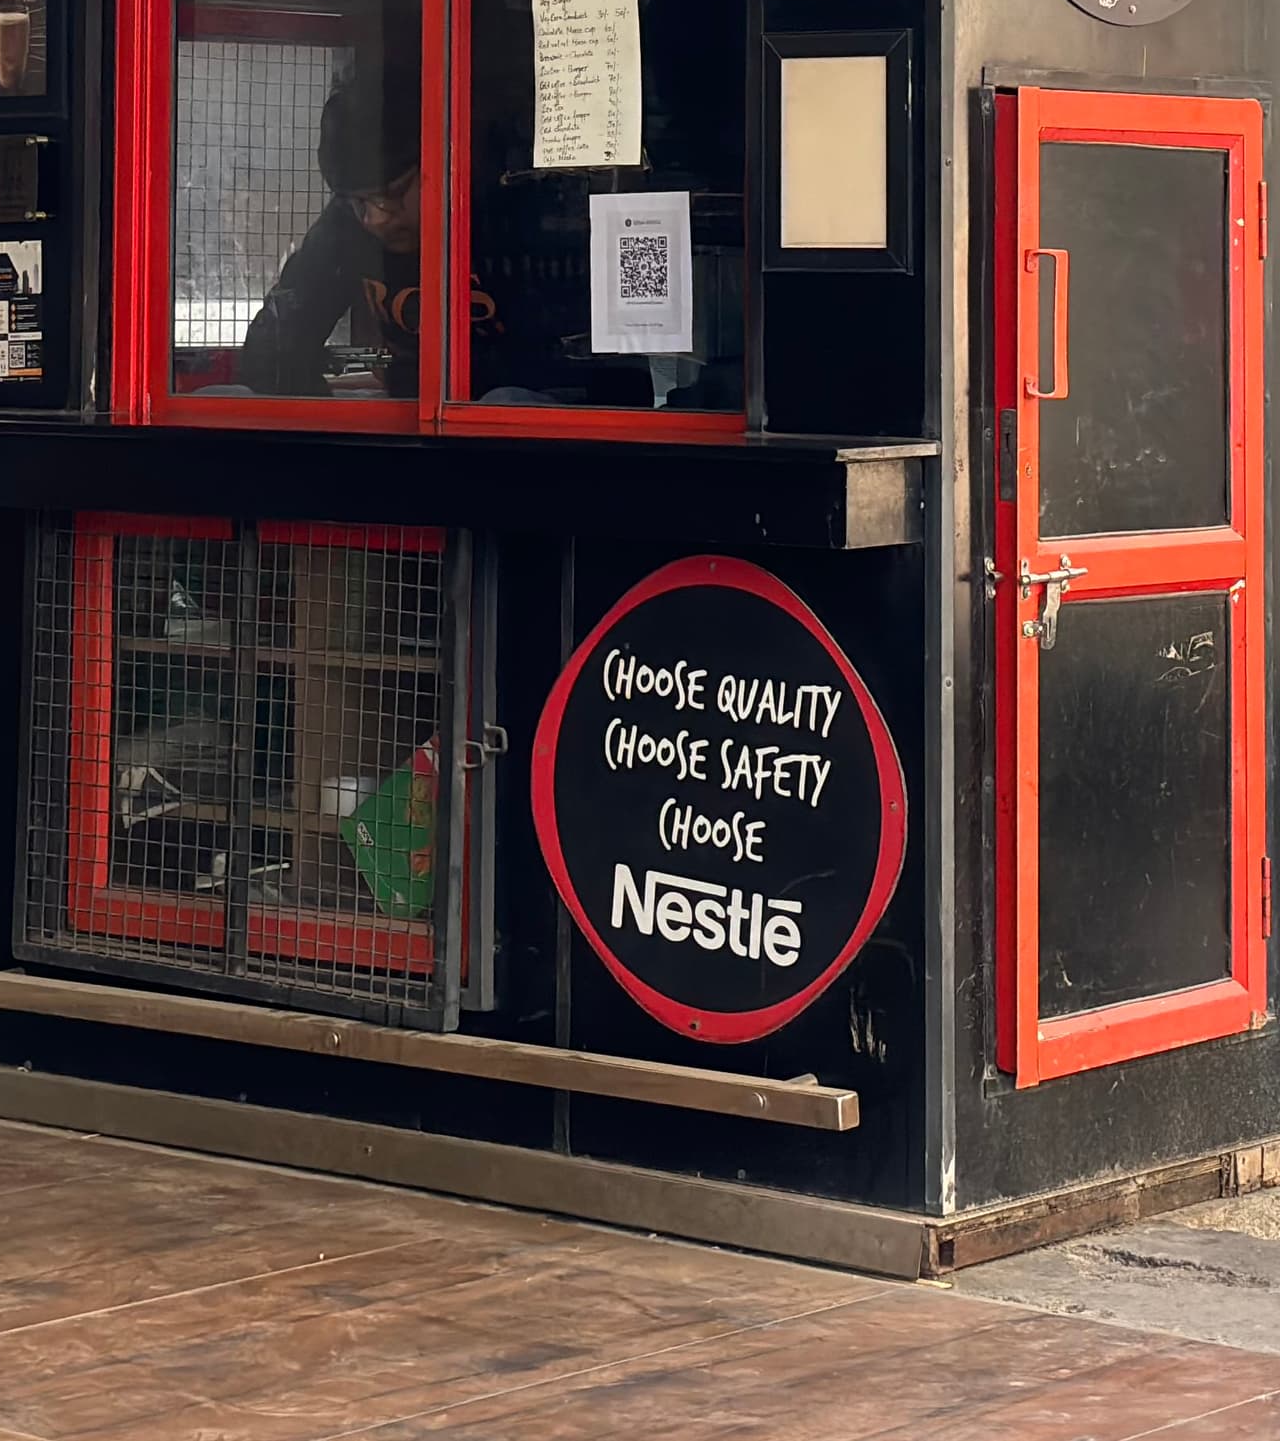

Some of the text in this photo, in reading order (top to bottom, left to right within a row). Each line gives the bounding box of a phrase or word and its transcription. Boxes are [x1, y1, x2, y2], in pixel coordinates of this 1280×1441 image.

[602, 648, 843, 738] CHOOSE QUALITY
[604, 718, 832, 808] CHOOSE SAFETY
[659, 798, 766, 863] CHOOSE
